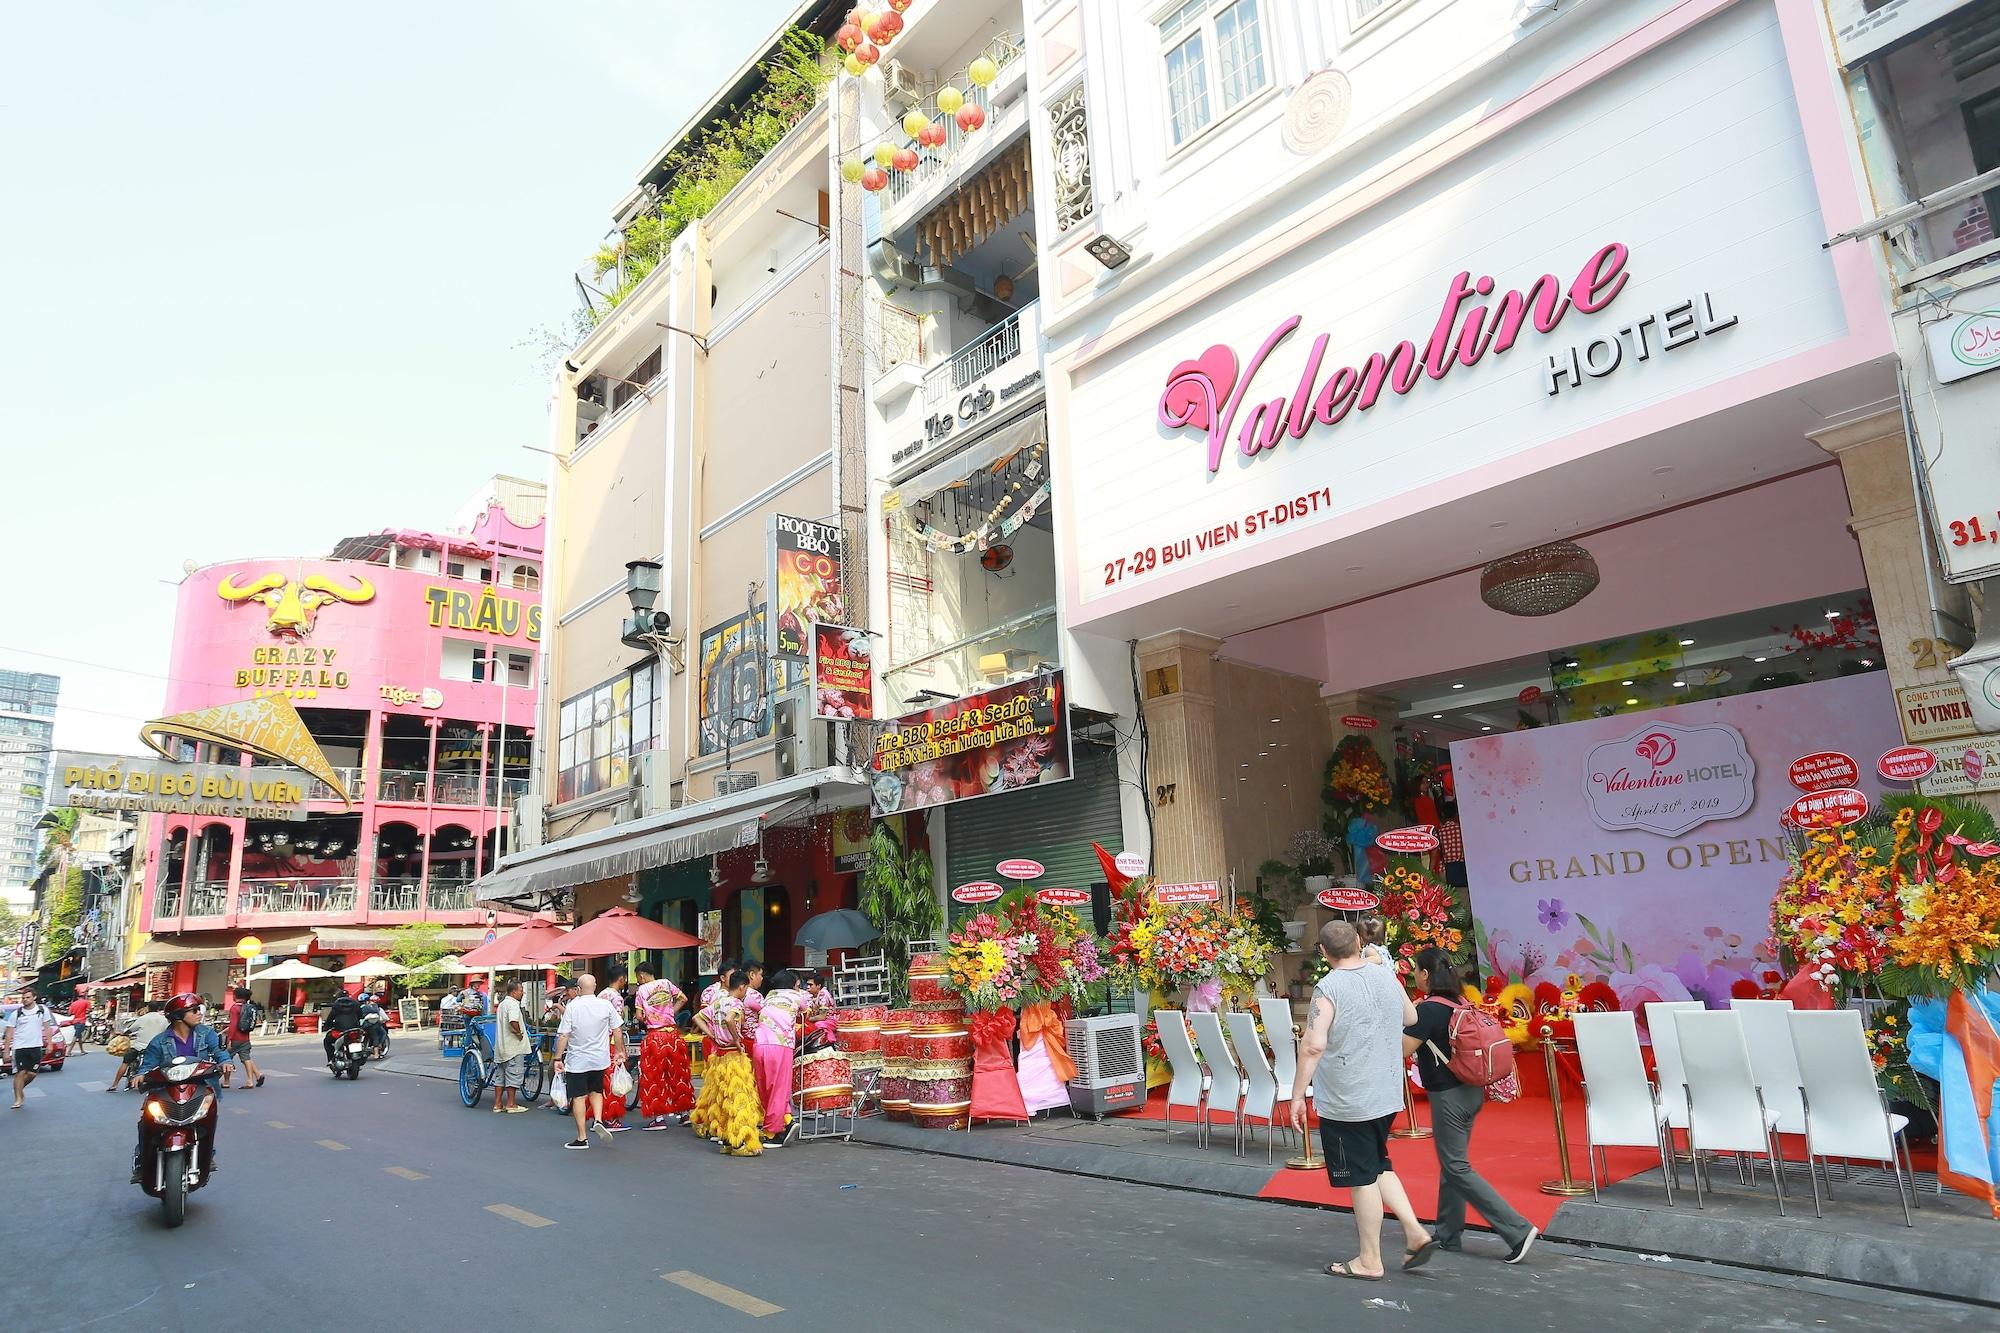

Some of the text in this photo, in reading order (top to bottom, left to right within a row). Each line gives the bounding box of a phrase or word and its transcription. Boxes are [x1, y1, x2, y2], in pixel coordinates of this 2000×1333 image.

[1543, 290, 1739, 397] HOTEL
[1157, 241, 1630, 474] Valentine
[924, 383, 995, 442] The Crib
[797, 533, 830, 557] BBQ
[1103, 487, 1333, 588] 27-29 BUI VIEN ST-DIST1
[425, 585, 522, 636] TRÂU
[253, 646, 337, 667] CRAZY
[819, 656, 869, 670] Fire BBQ Beef
[234, 668, 350, 689] BUFFALO
[833, 668, 864, 679] Seafood
[379, 685, 421, 706] Tiger
[1930, 690, 1940, 699] TY
[875, 696, 1037, 753] Fire BBQ Beef & Seafoo
[1908, 703, 1927, 726] VŨ
[1928, 702, 1962, 723] VINH
[1952, 744, 1973, 752] TNHH
[64, 756, 301, 808] PHỐ ĐI BỘ BÙI VIỆN
[1593, 763, 1743, 793] Valentine HOTEL
[105, 795, 147, 811] VIEN
[152, 800, 230, 818] WALKING
[233, 804, 293, 821] STREET
[1156, 783, 1177, 808] 27
[1621, 802, 1659, 821] April
[1690, 797, 1720, 811] 2019
[1509, 836, 1787, 883] GRAND OPEN
